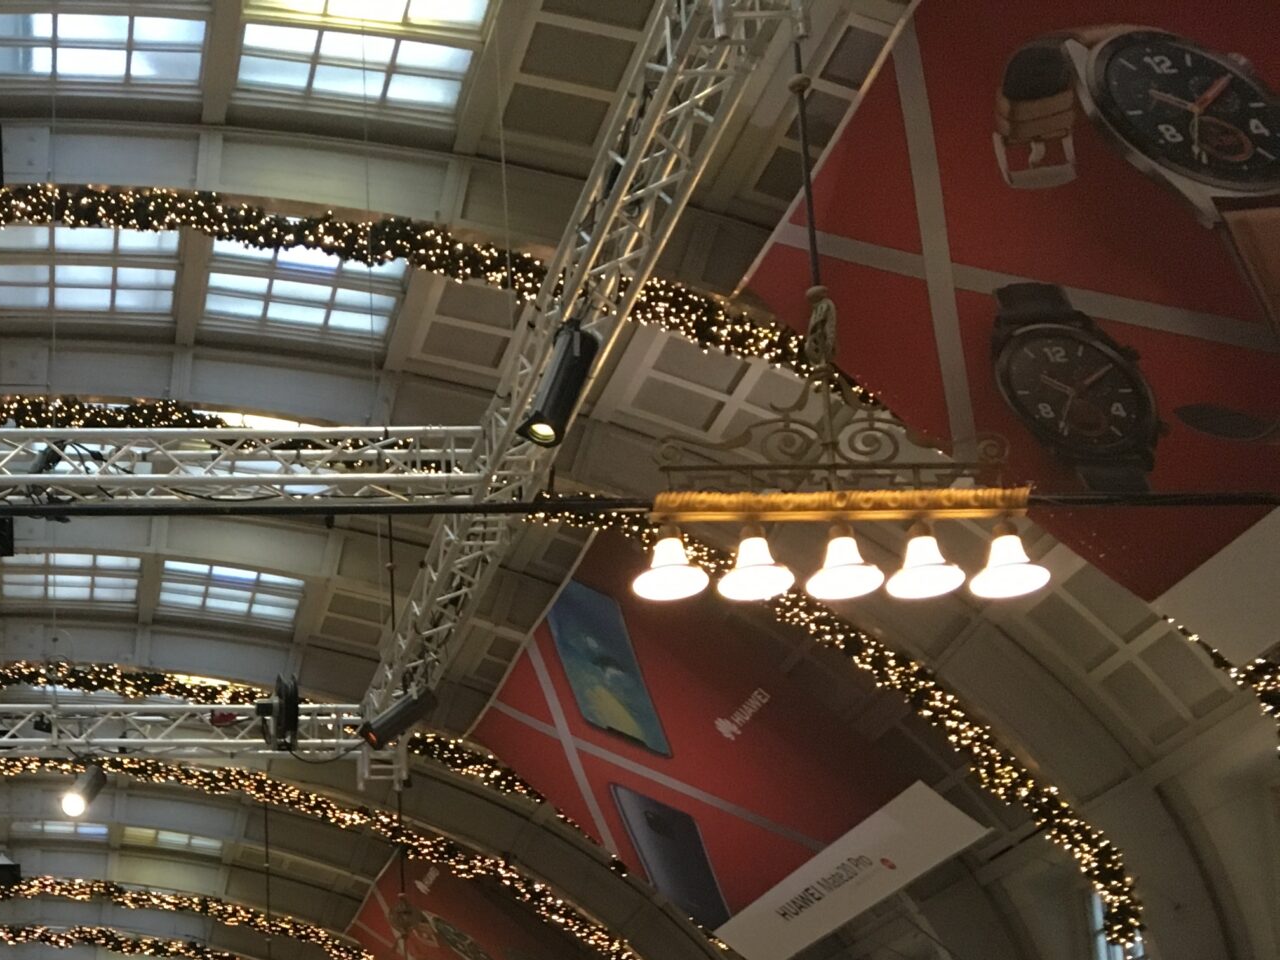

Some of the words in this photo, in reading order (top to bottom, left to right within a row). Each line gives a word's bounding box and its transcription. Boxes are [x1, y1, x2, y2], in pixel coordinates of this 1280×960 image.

[1143, 56, 1179, 74] 12
[1157, 124, 1184, 142] 8
[1249, 118, 1269, 136] 4
[1044, 347, 1069, 362] 12
[775, 885, 823, 922] HUAWEI
